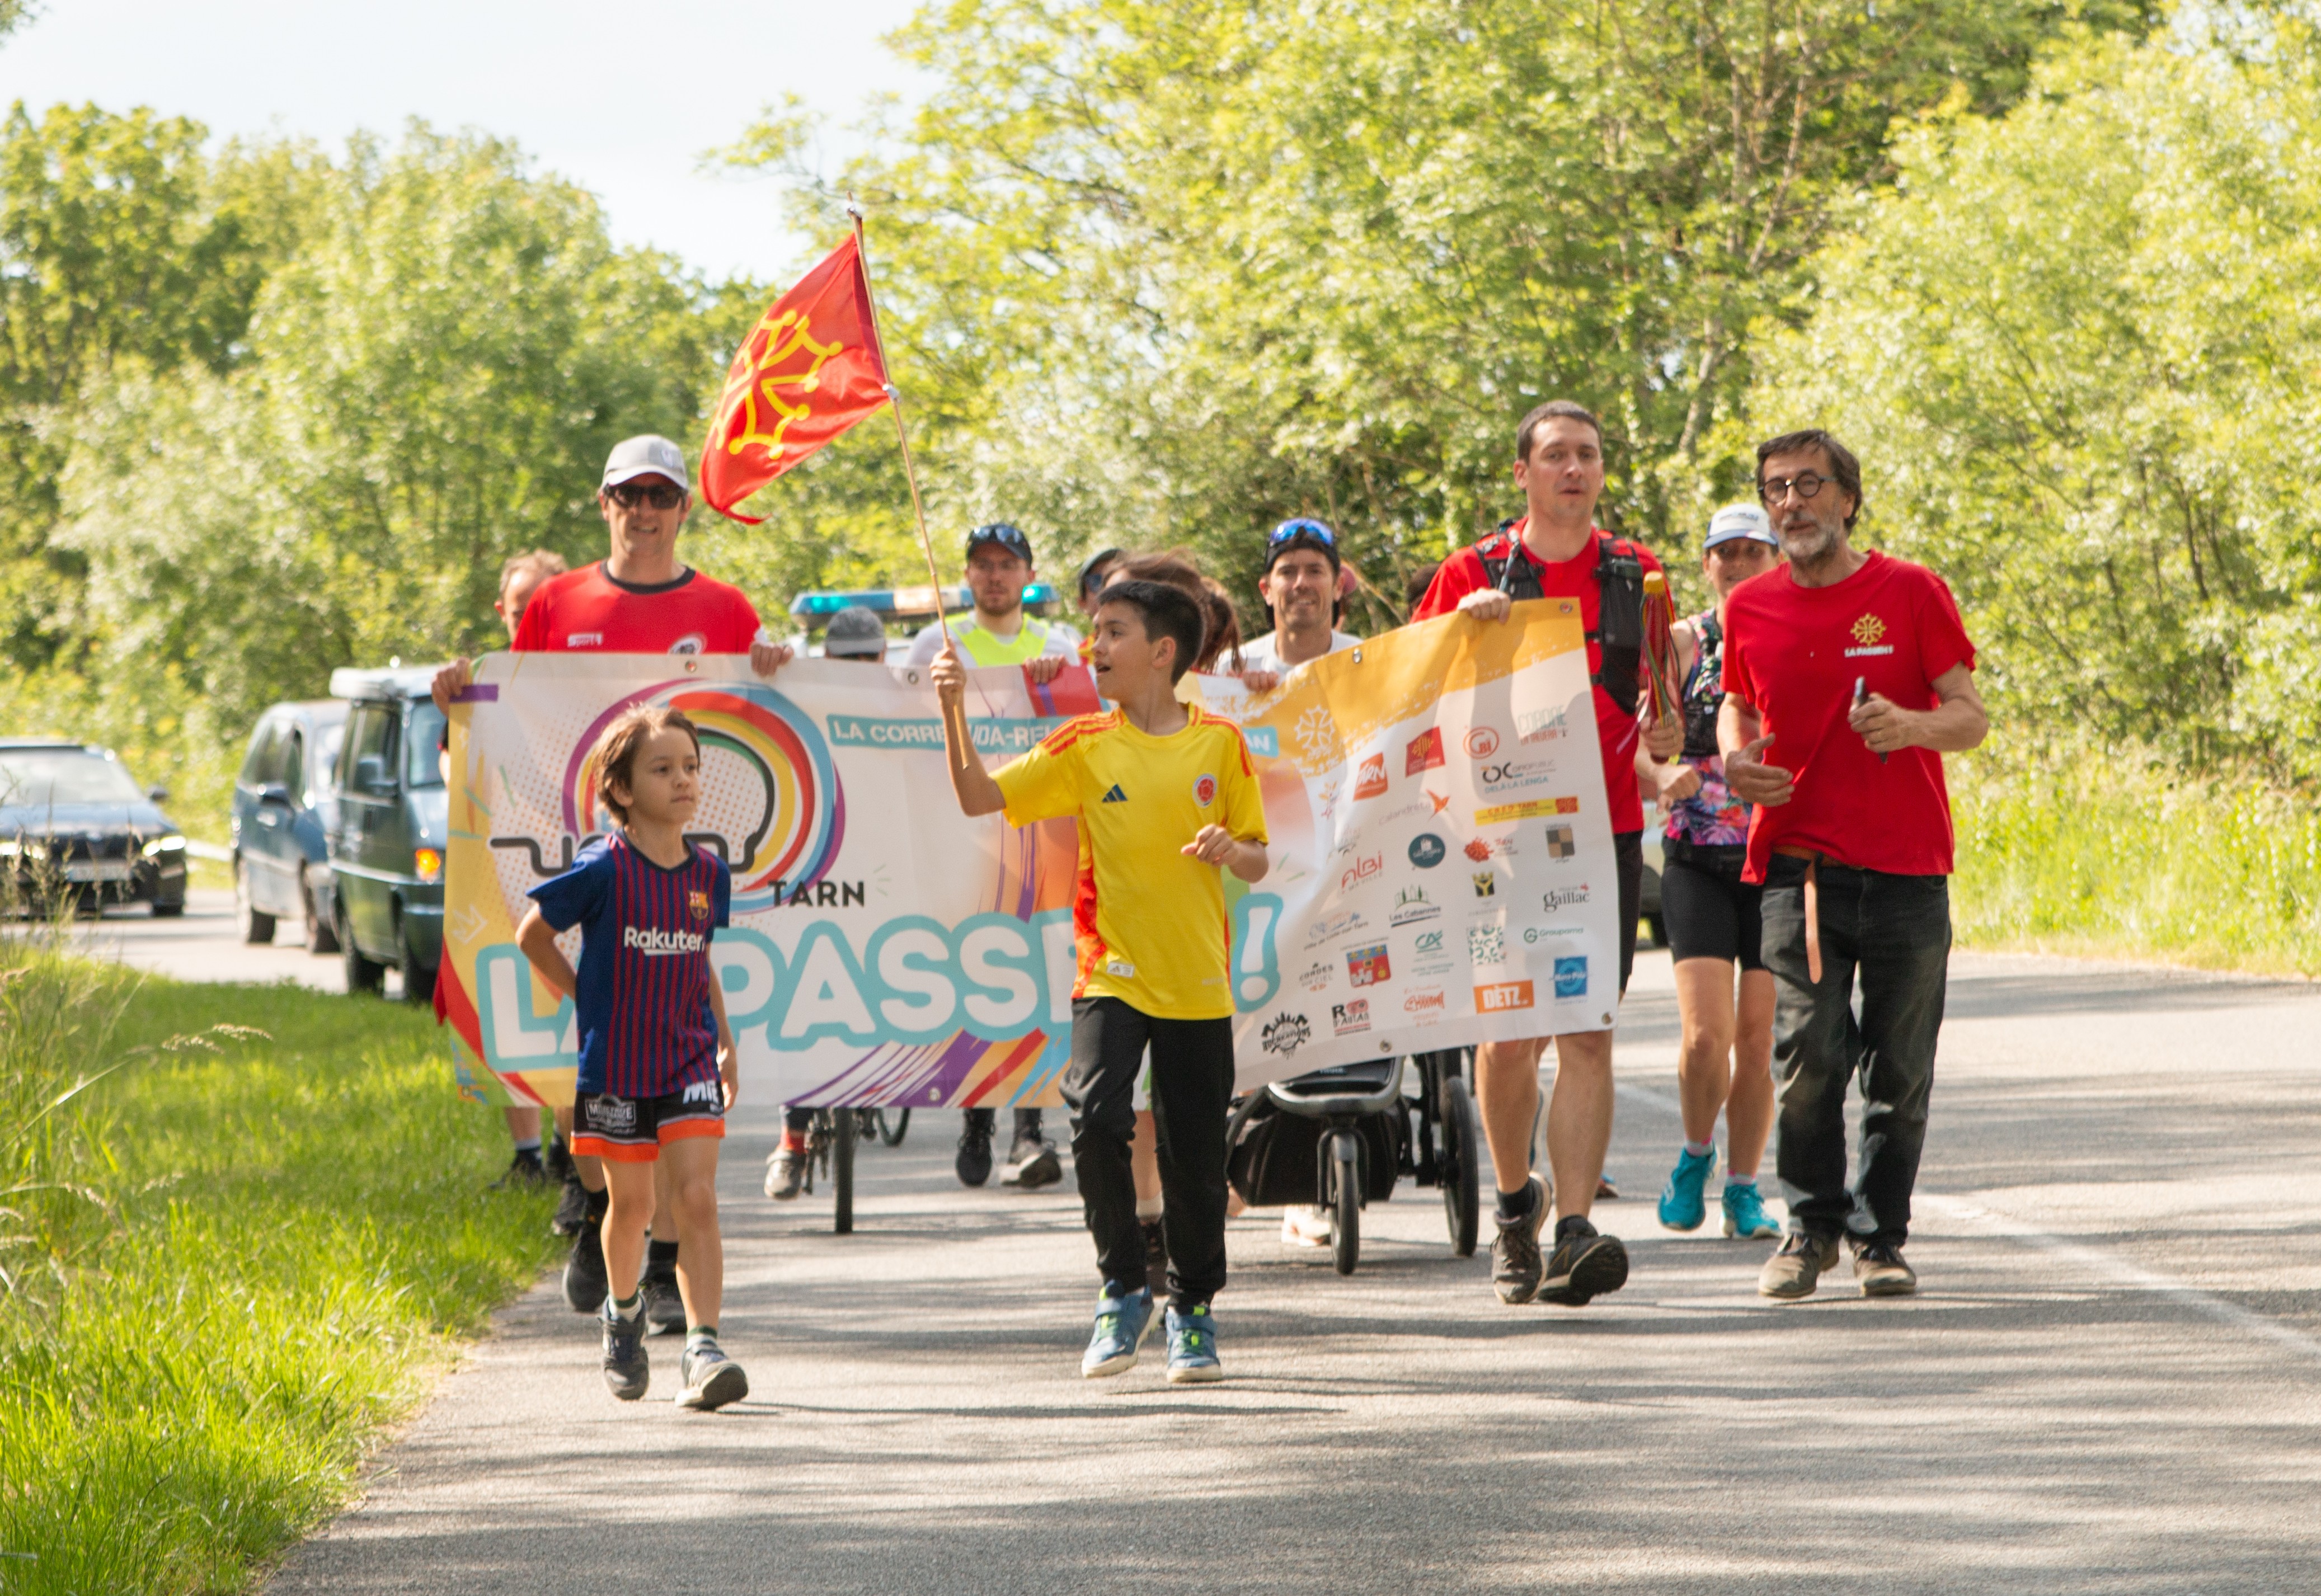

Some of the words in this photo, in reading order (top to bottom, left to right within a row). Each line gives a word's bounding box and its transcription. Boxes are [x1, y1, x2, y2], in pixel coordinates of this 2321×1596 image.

[833, 721, 864, 740] LA
[768, 880, 865, 908] TARN
[1543, 891, 1590, 913] gaillac
[1404, 906, 1441, 918] Cabannes
[1540, 927, 1584, 937] Groupama
[482, 945, 579, 1066] L
